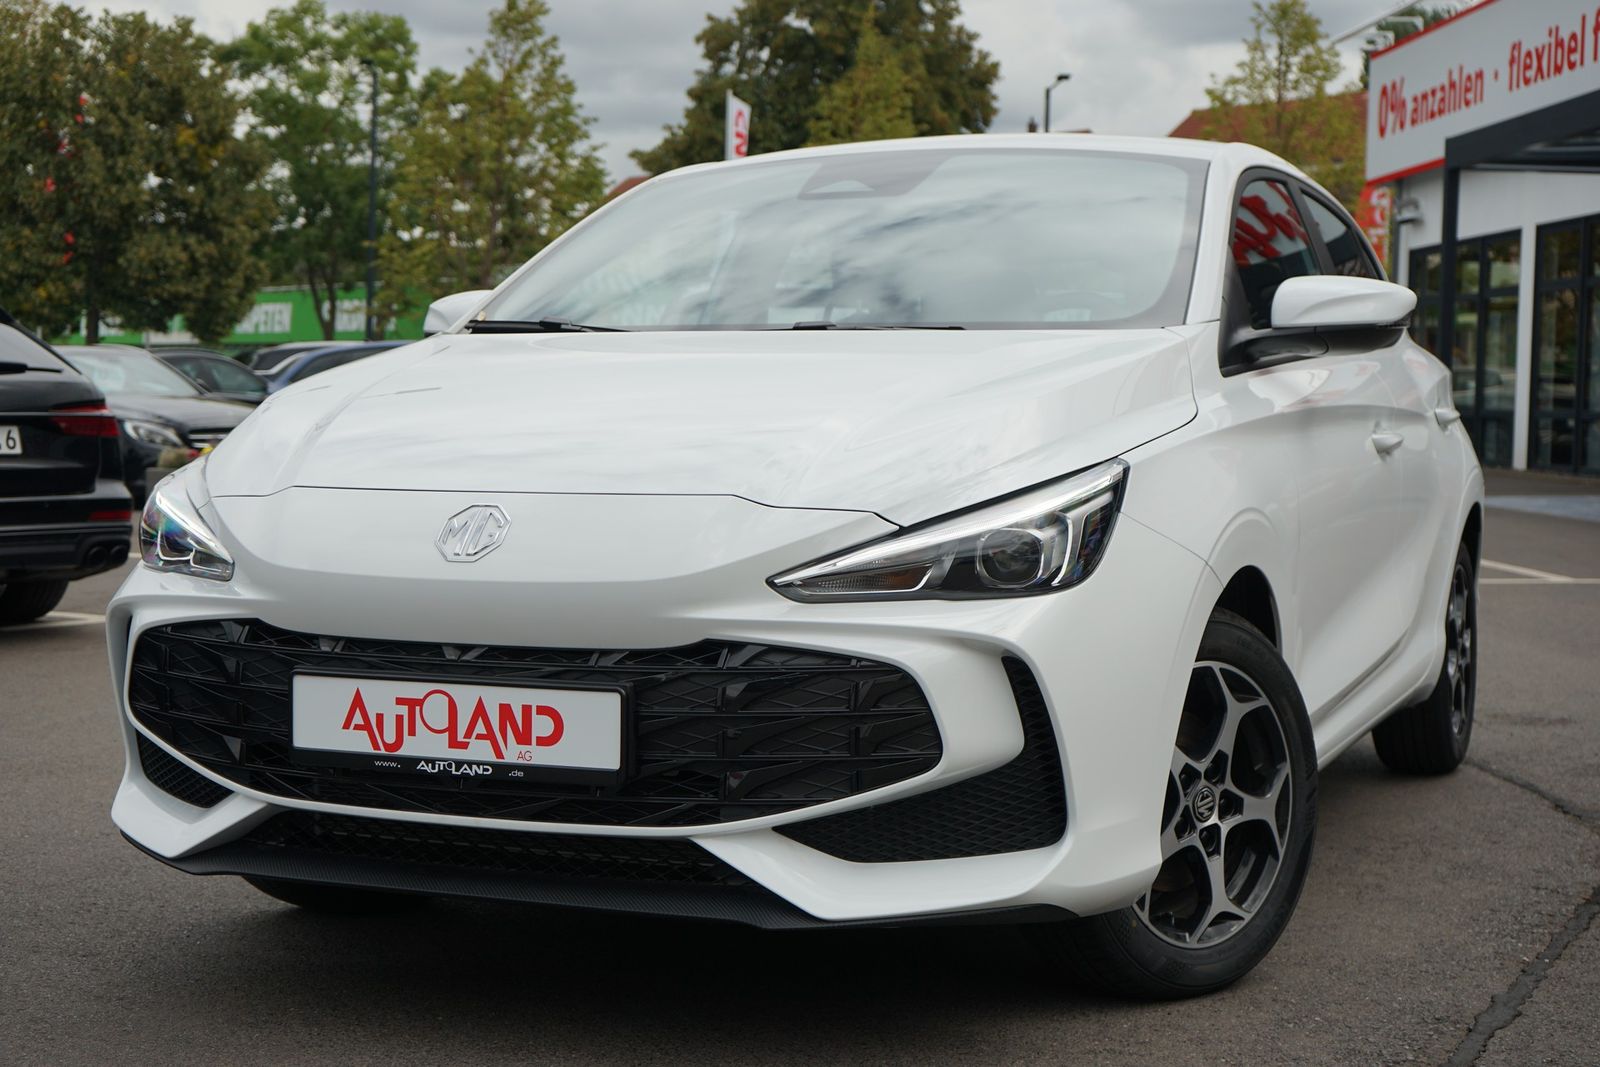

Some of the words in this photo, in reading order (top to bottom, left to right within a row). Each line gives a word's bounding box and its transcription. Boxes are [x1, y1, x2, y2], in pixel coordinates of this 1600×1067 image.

[1379, 76, 1407, 139] 0%
[1410, 64, 1485, 127] anzahlen
[1508, 13, 1587, 92] flexibel
[438, 506, 507, 560] MG
[516, 750, 533, 762] AG
[508, 769, 524, 777] .de
